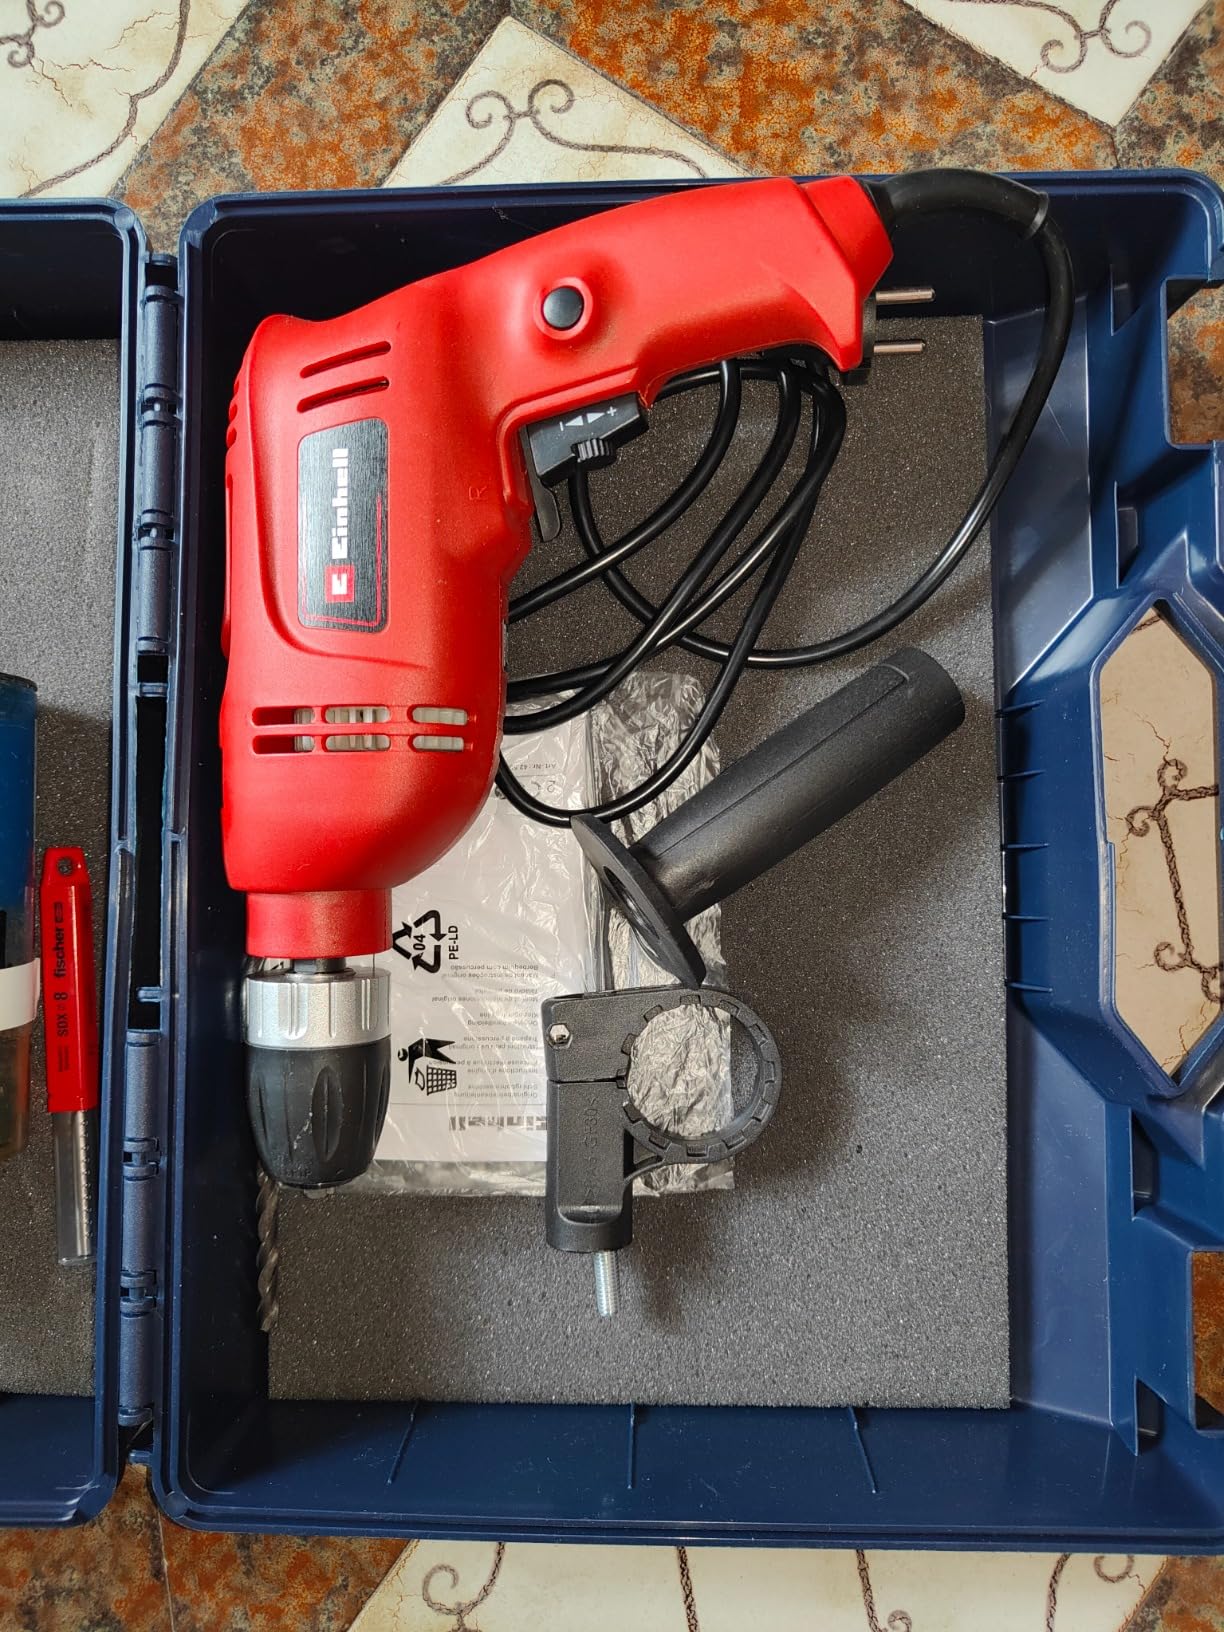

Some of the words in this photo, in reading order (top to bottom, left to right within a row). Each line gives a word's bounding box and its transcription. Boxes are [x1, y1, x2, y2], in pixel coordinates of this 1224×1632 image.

[331, 448, 349, 560] Einhell
[54, 927, 67, 979] fischer
[412, 933, 426, 951] 04
[447, 925, 460, 960] PE-LD
[54, 991, 69, 1001] 8
